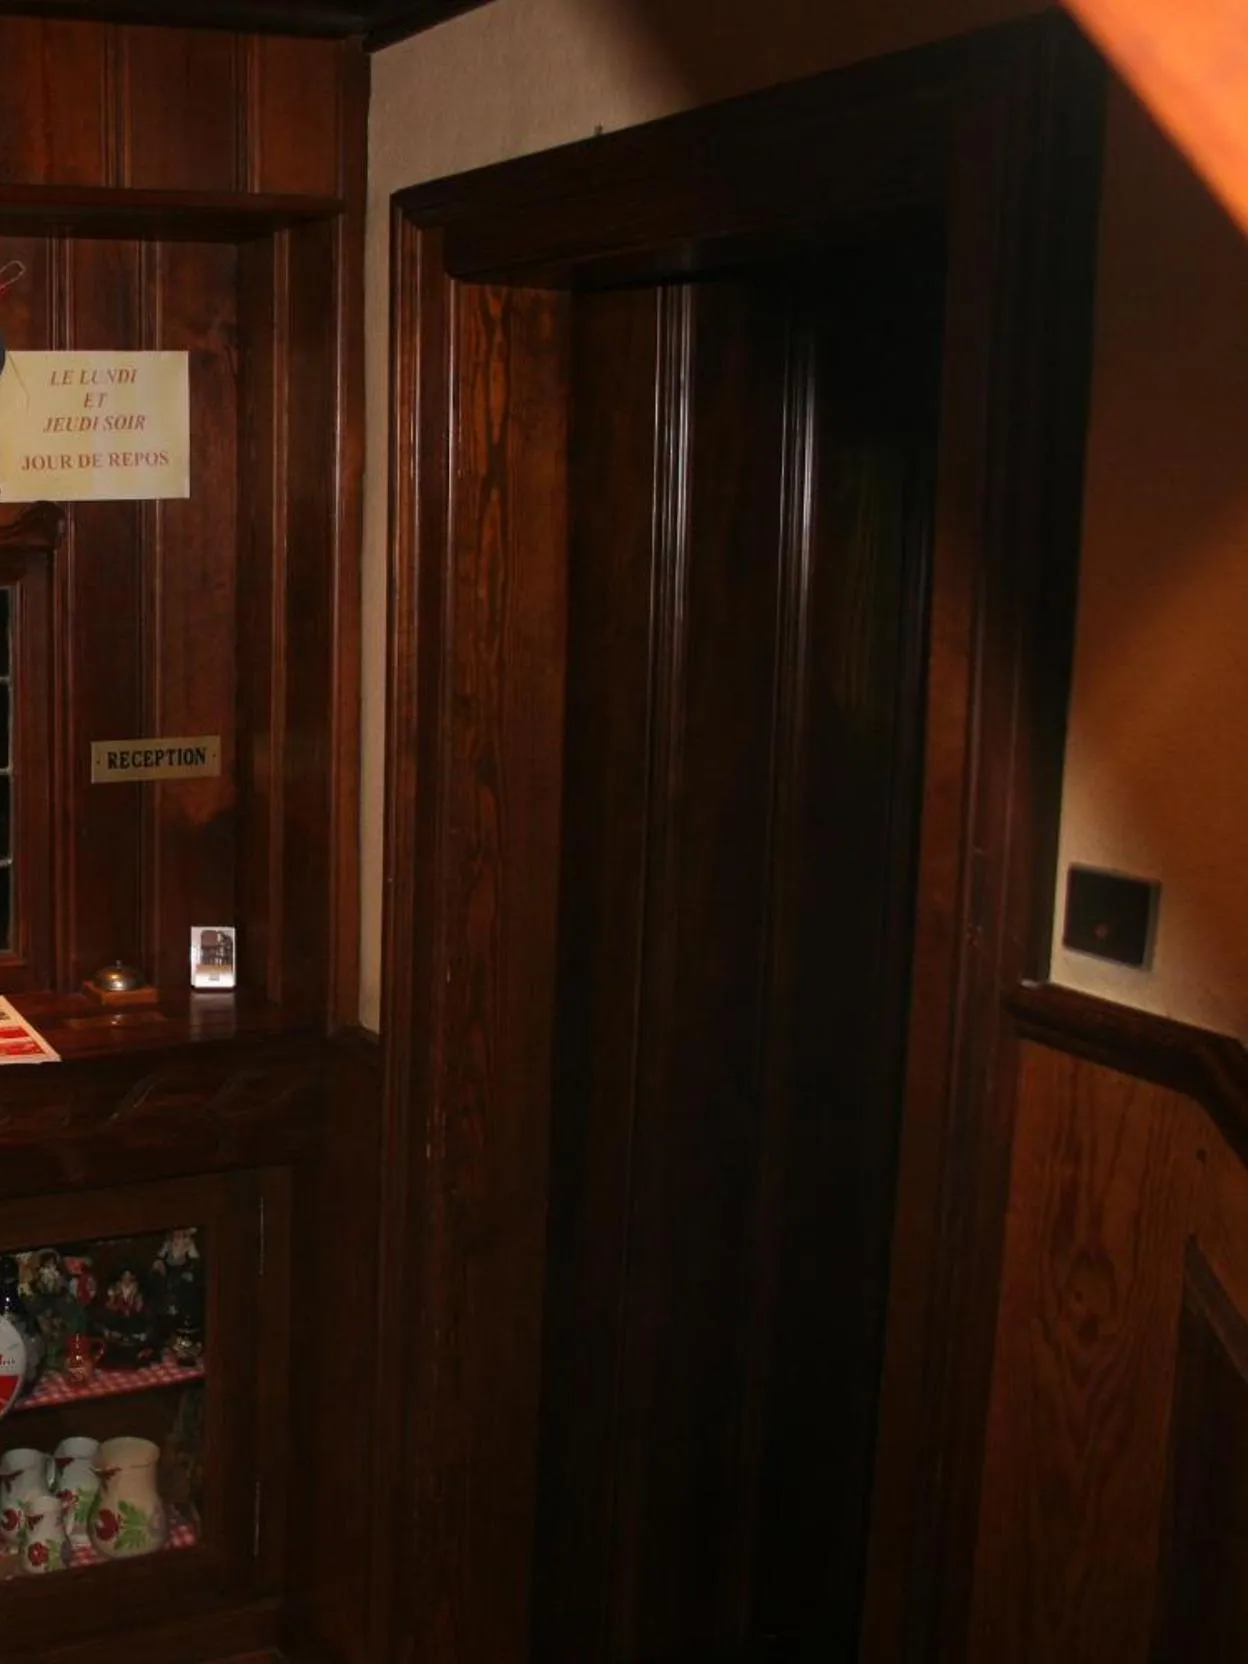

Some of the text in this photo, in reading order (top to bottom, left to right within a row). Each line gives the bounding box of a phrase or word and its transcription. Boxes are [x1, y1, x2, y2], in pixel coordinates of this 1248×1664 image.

[50, 368, 137, 386] LE LUNDI
[83, 391, 108, 409] ET
[42, 415, 146, 433] JEUDI SOIR
[21, 451, 170, 472] JOUR DE REPOS
[107, 747, 206, 769] RECEPTION
